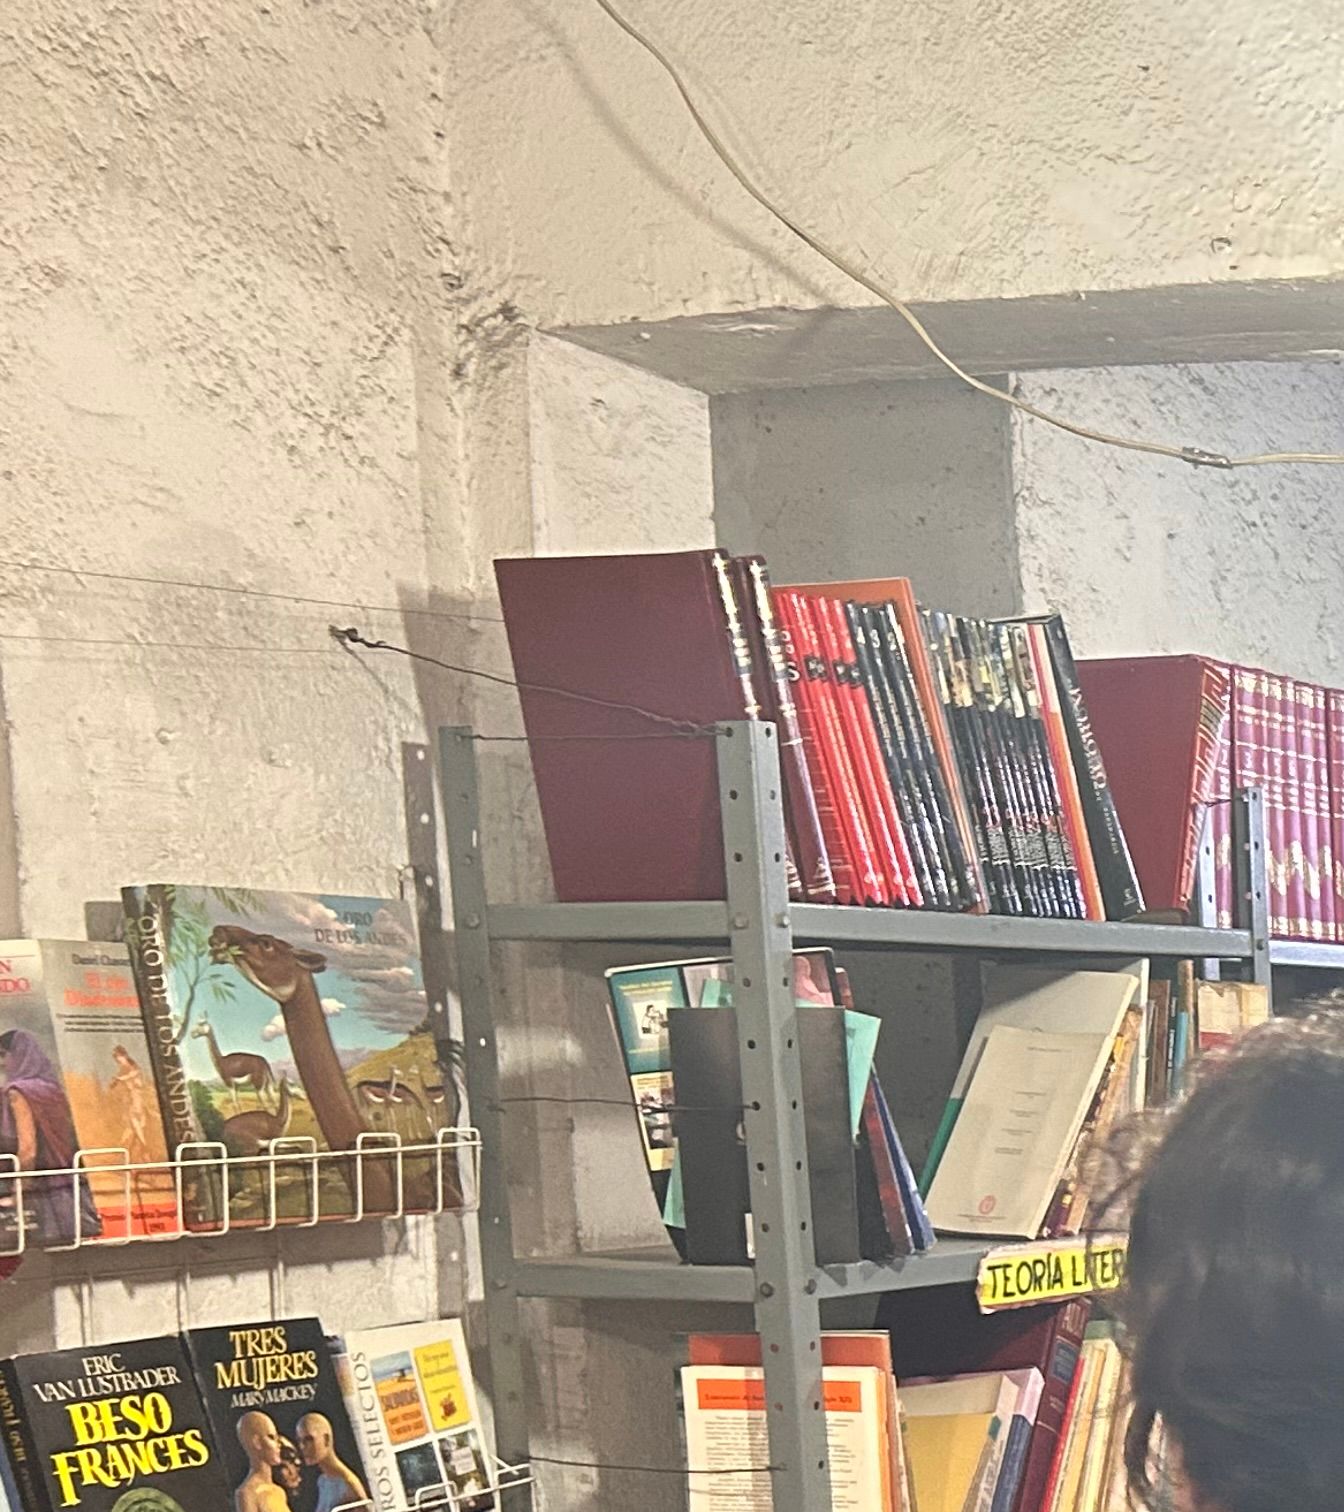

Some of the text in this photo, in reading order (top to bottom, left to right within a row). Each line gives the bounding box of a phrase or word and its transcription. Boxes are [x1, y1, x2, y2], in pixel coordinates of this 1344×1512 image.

[138, 914, 164, 969] ORO
[163, 1061, 196, 1145] ANDES
[986, 1252, 1064, 1300] TEORÍA
[82, 1353, 124, 1377] ERIC
[230, 1327, 288, 1358] TRES
[33, 1366, 182, 1403] VAN LUSTBADER
[215, 1347, 319, 1390] MUJERES
[65, 1391, 174, 1447] BESO
[350, 1350, 389, 1471] SELECTOS
[51, 1429, 211, 1508] FRANCES
